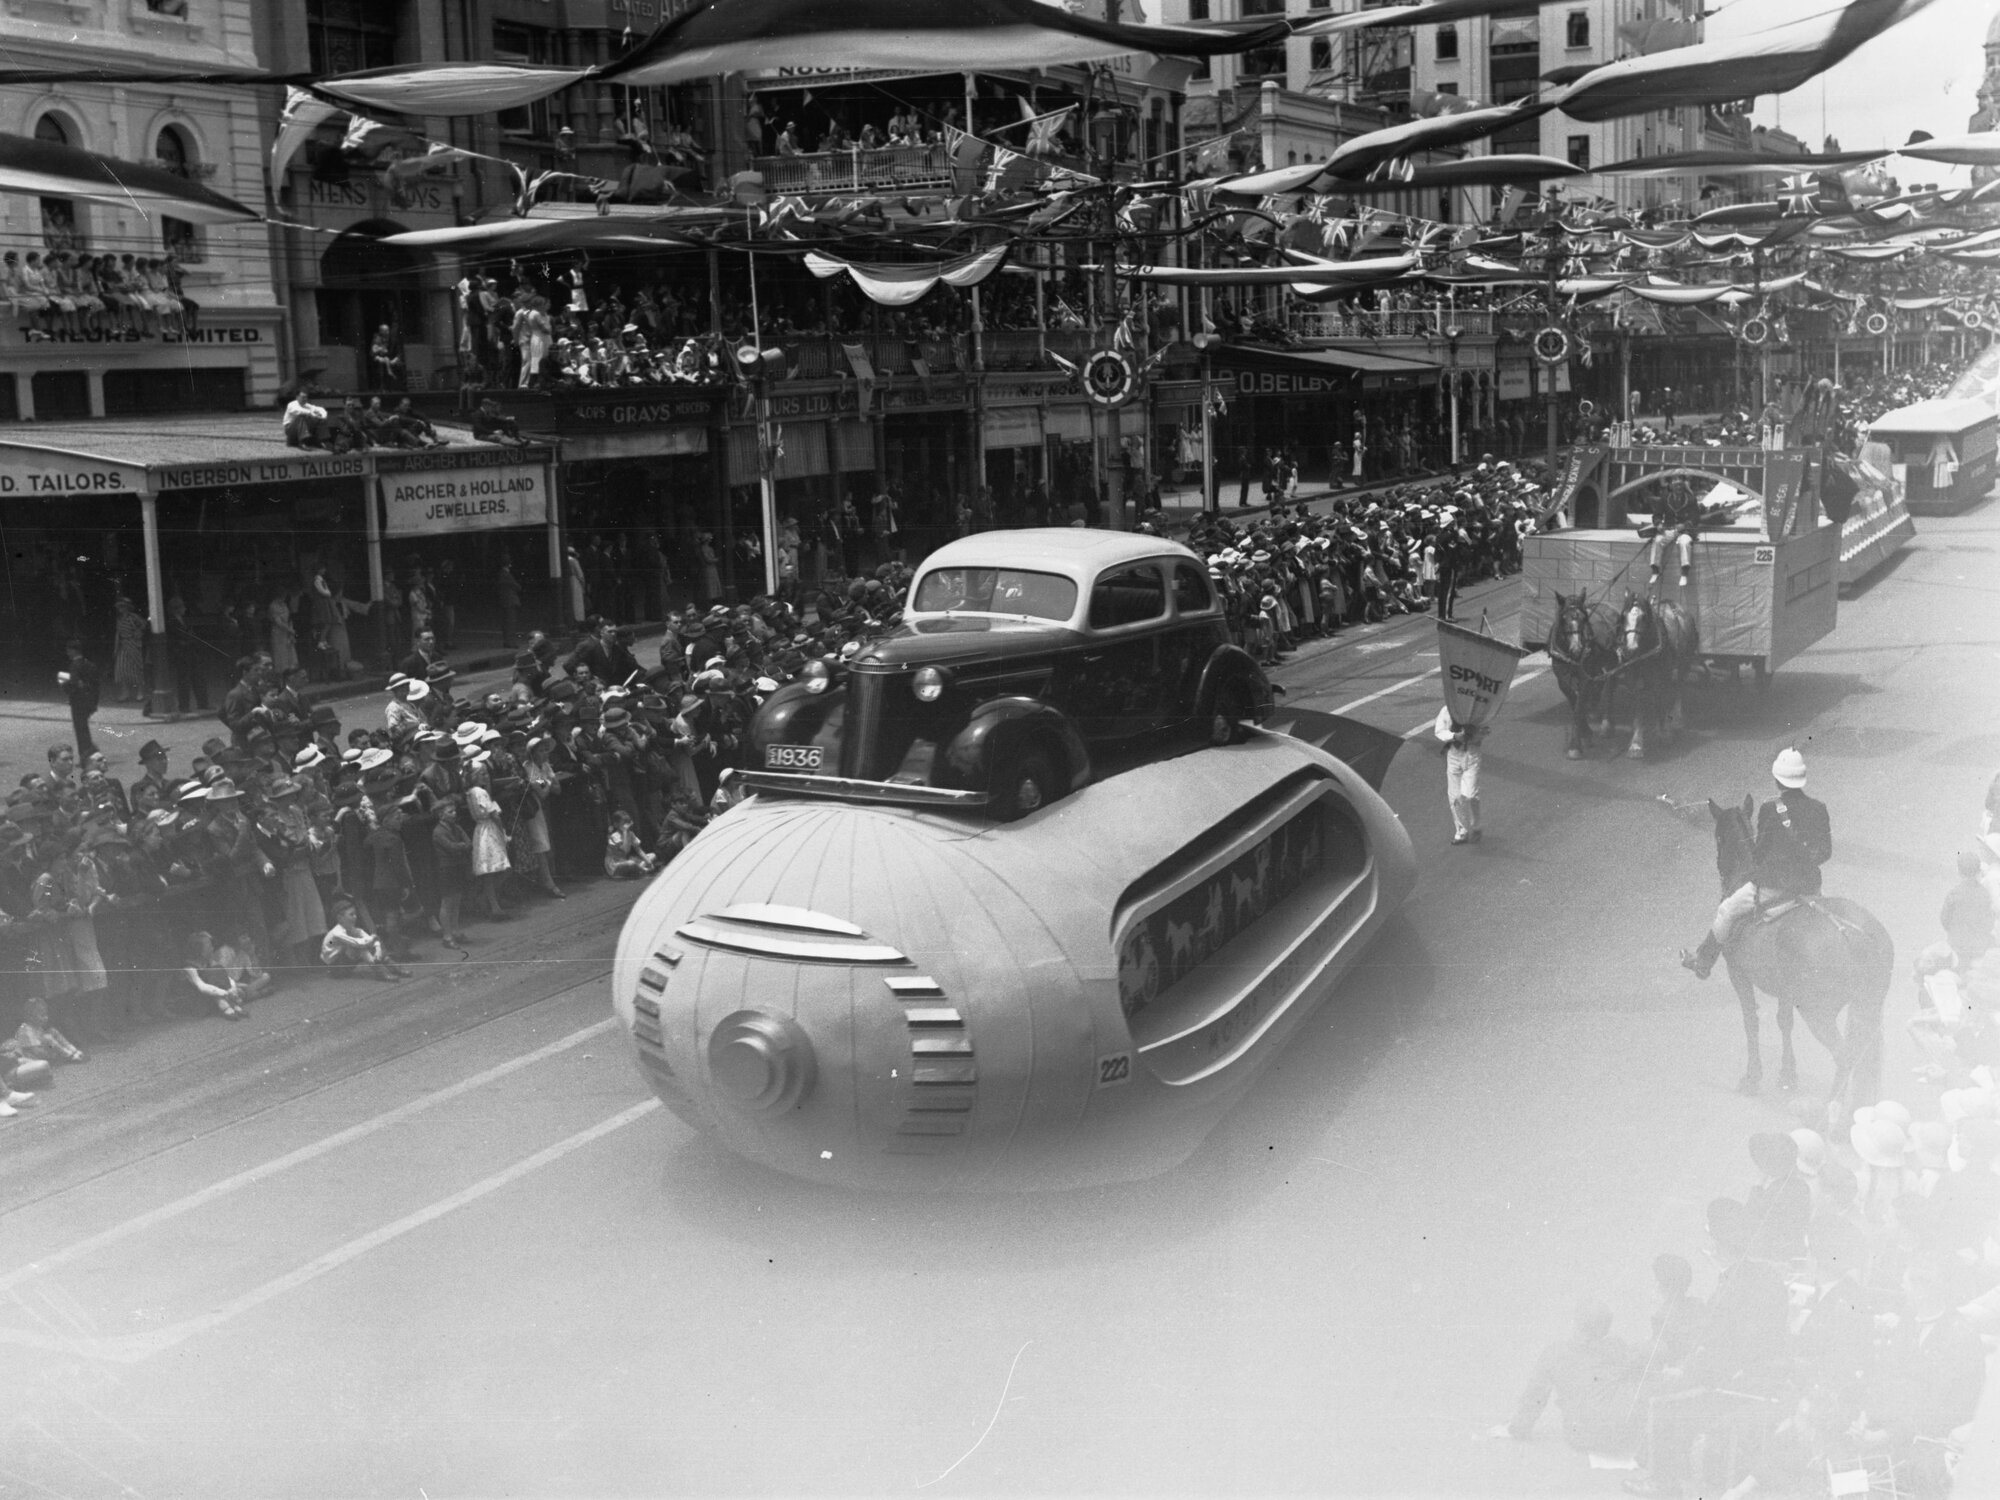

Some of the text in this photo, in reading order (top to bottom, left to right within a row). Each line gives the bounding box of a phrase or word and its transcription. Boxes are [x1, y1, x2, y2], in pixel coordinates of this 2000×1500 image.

[162, 328, 263, 344] LIMITED.
[612, 403, 671, 423] GRAYS
[404, 454, 457, 471] ARCHER
[469, 450, 525, 467] HOLLAND
[28, 472, 126, 492] TAILORS.
[160, 466, 251, 489] INGERSON
[260, 463, 292, 481] LTD.
[301, 459, 364, 477] TAILORS
[394, 477, 535, 502] ARCHER & HOLLAND
[425, 499, 510, 520] JEWELLERS.
[1756, 550, 1773, 562] 225
[776, 748, 821, 767] 1936
[1100, 1055, 1130, 1083] 223
